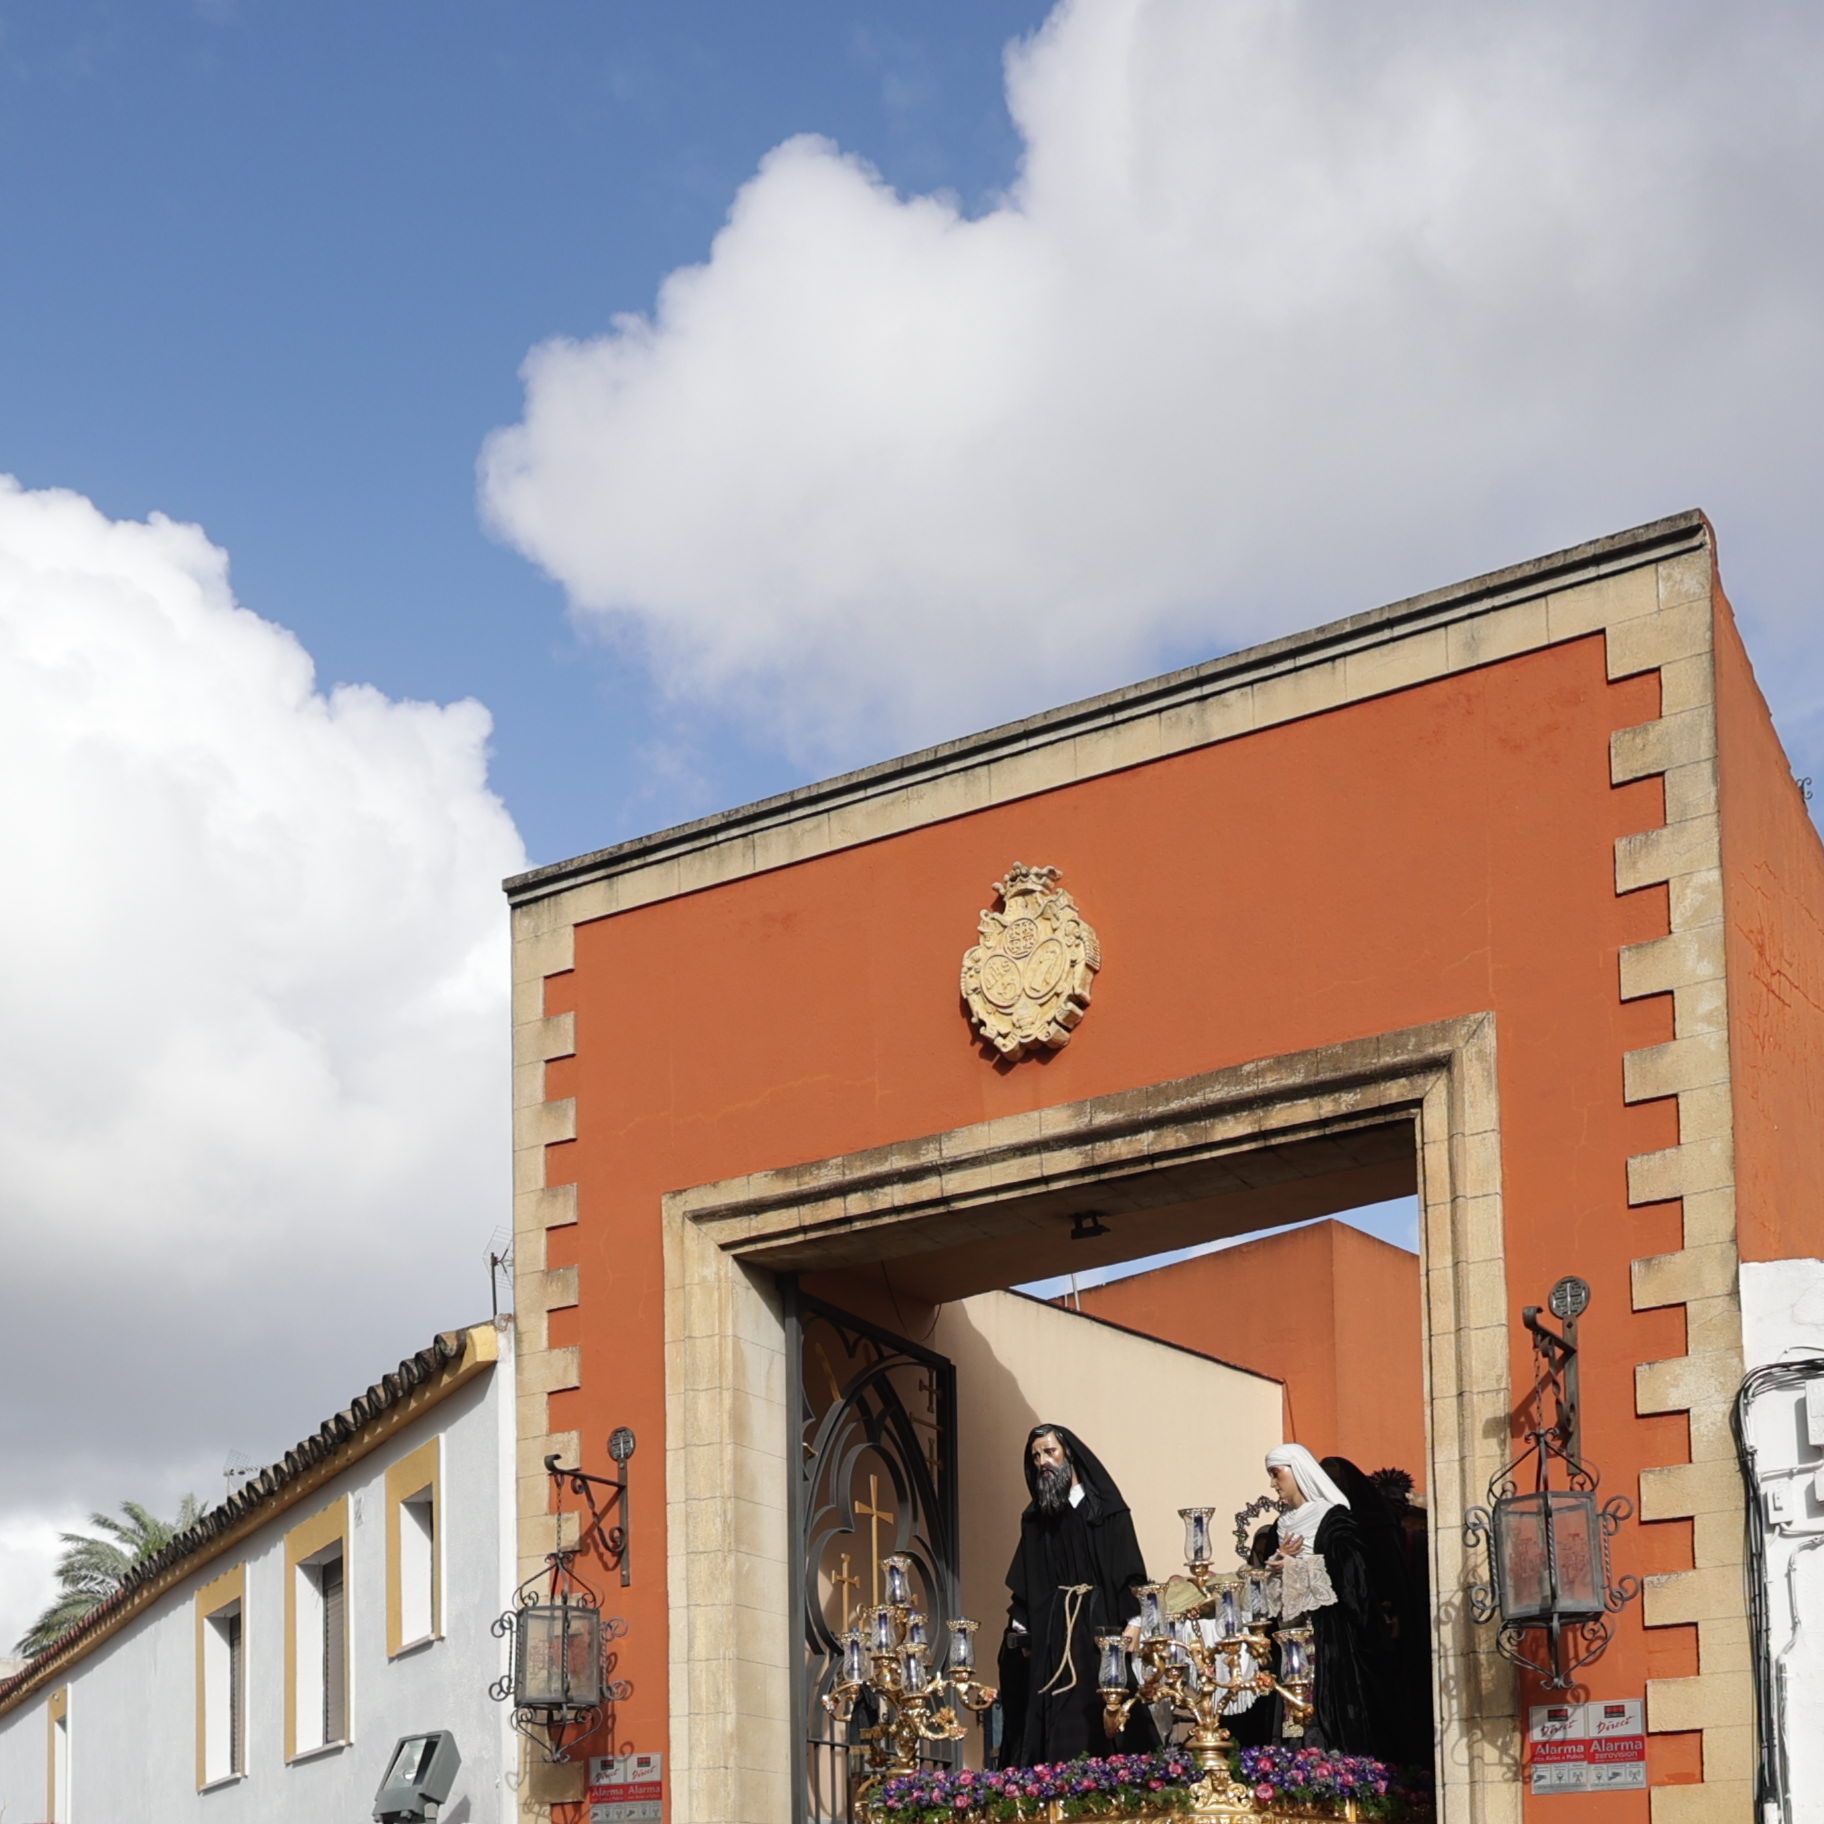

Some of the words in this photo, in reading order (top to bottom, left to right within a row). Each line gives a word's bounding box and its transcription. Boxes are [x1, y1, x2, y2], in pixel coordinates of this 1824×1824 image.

[1596, 1715, 1634, 1734] Direct
[1536, 1743, 1584, 1754] Alarma
[1590, 1740, 1642, 1752] Alarma
[592, 1787, 624, 1797] Alarma
[628, 1784, 660, 1795] Alarma
